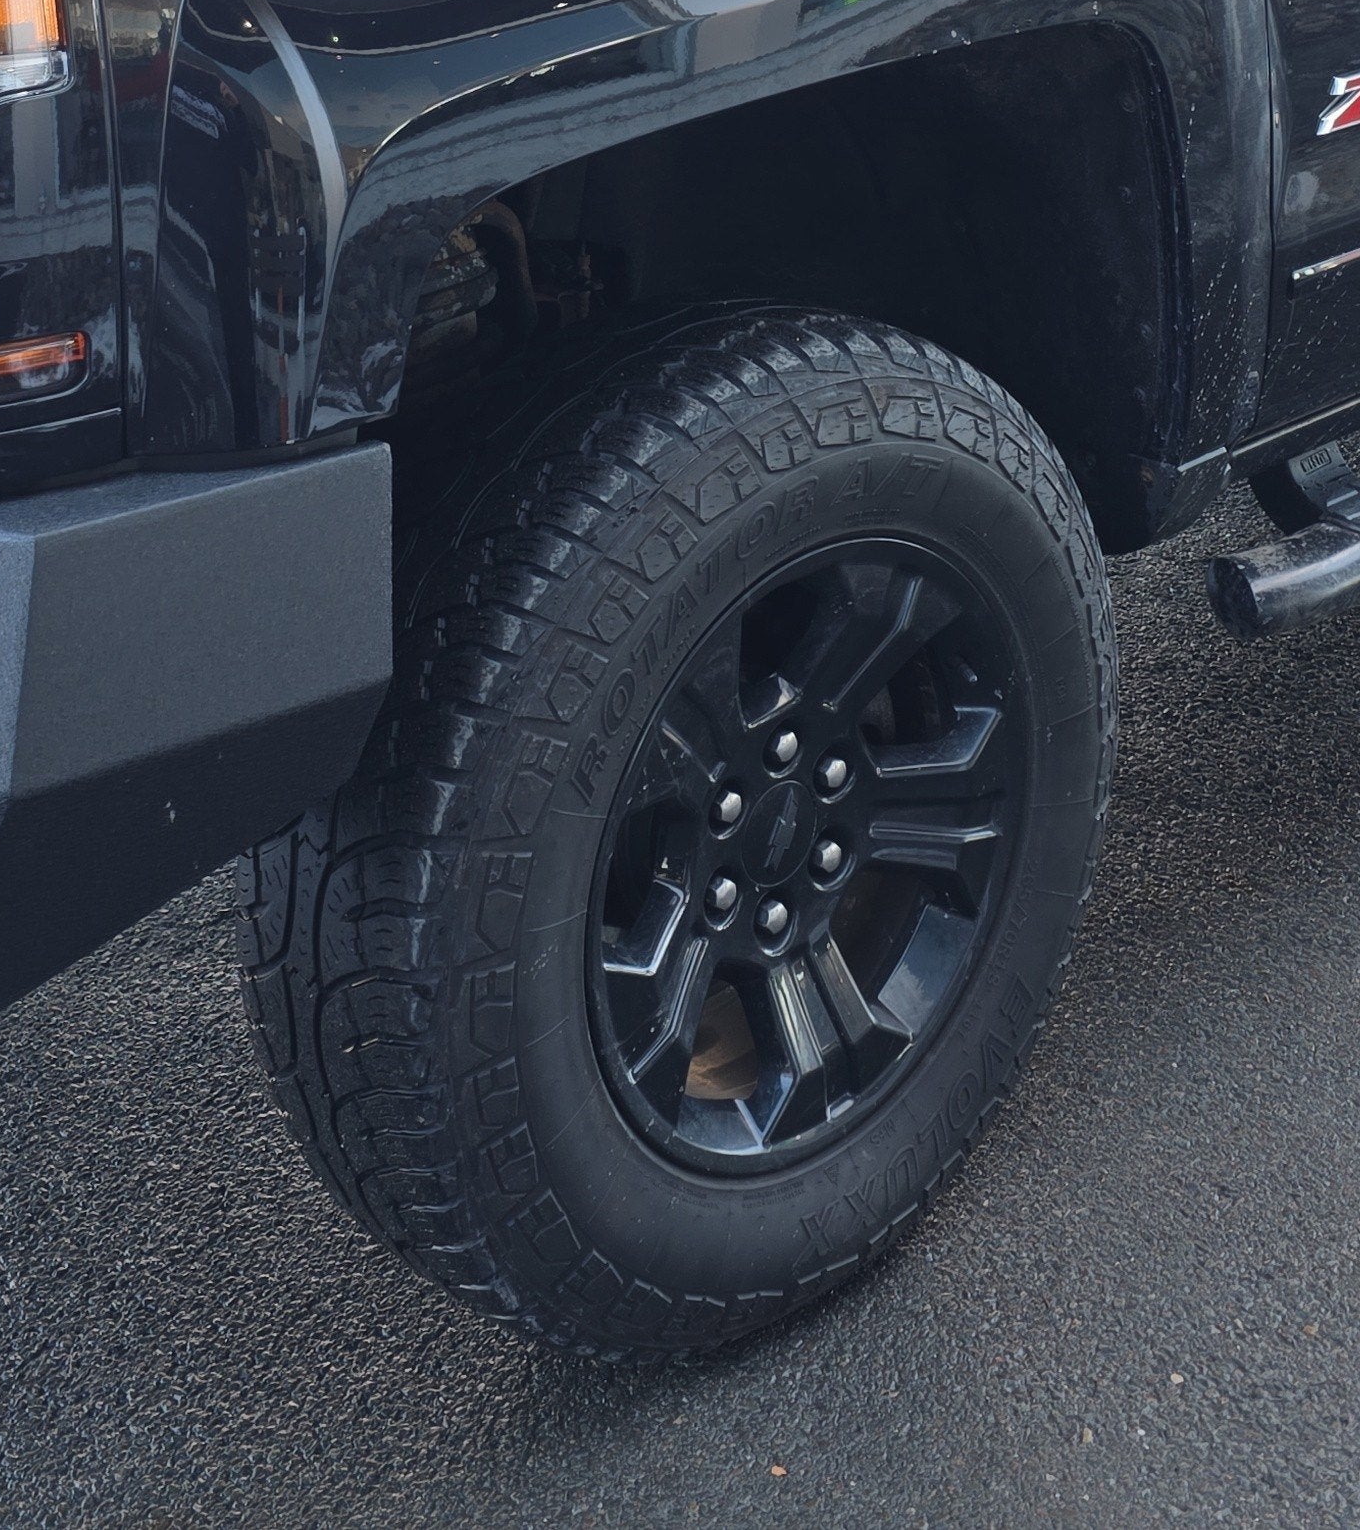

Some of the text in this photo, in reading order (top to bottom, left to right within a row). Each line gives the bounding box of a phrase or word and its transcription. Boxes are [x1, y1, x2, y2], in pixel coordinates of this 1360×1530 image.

[571, 451, 944, 806] ROTATOR A/T
[792, 970, 1037, 1270] EVOLUXX
